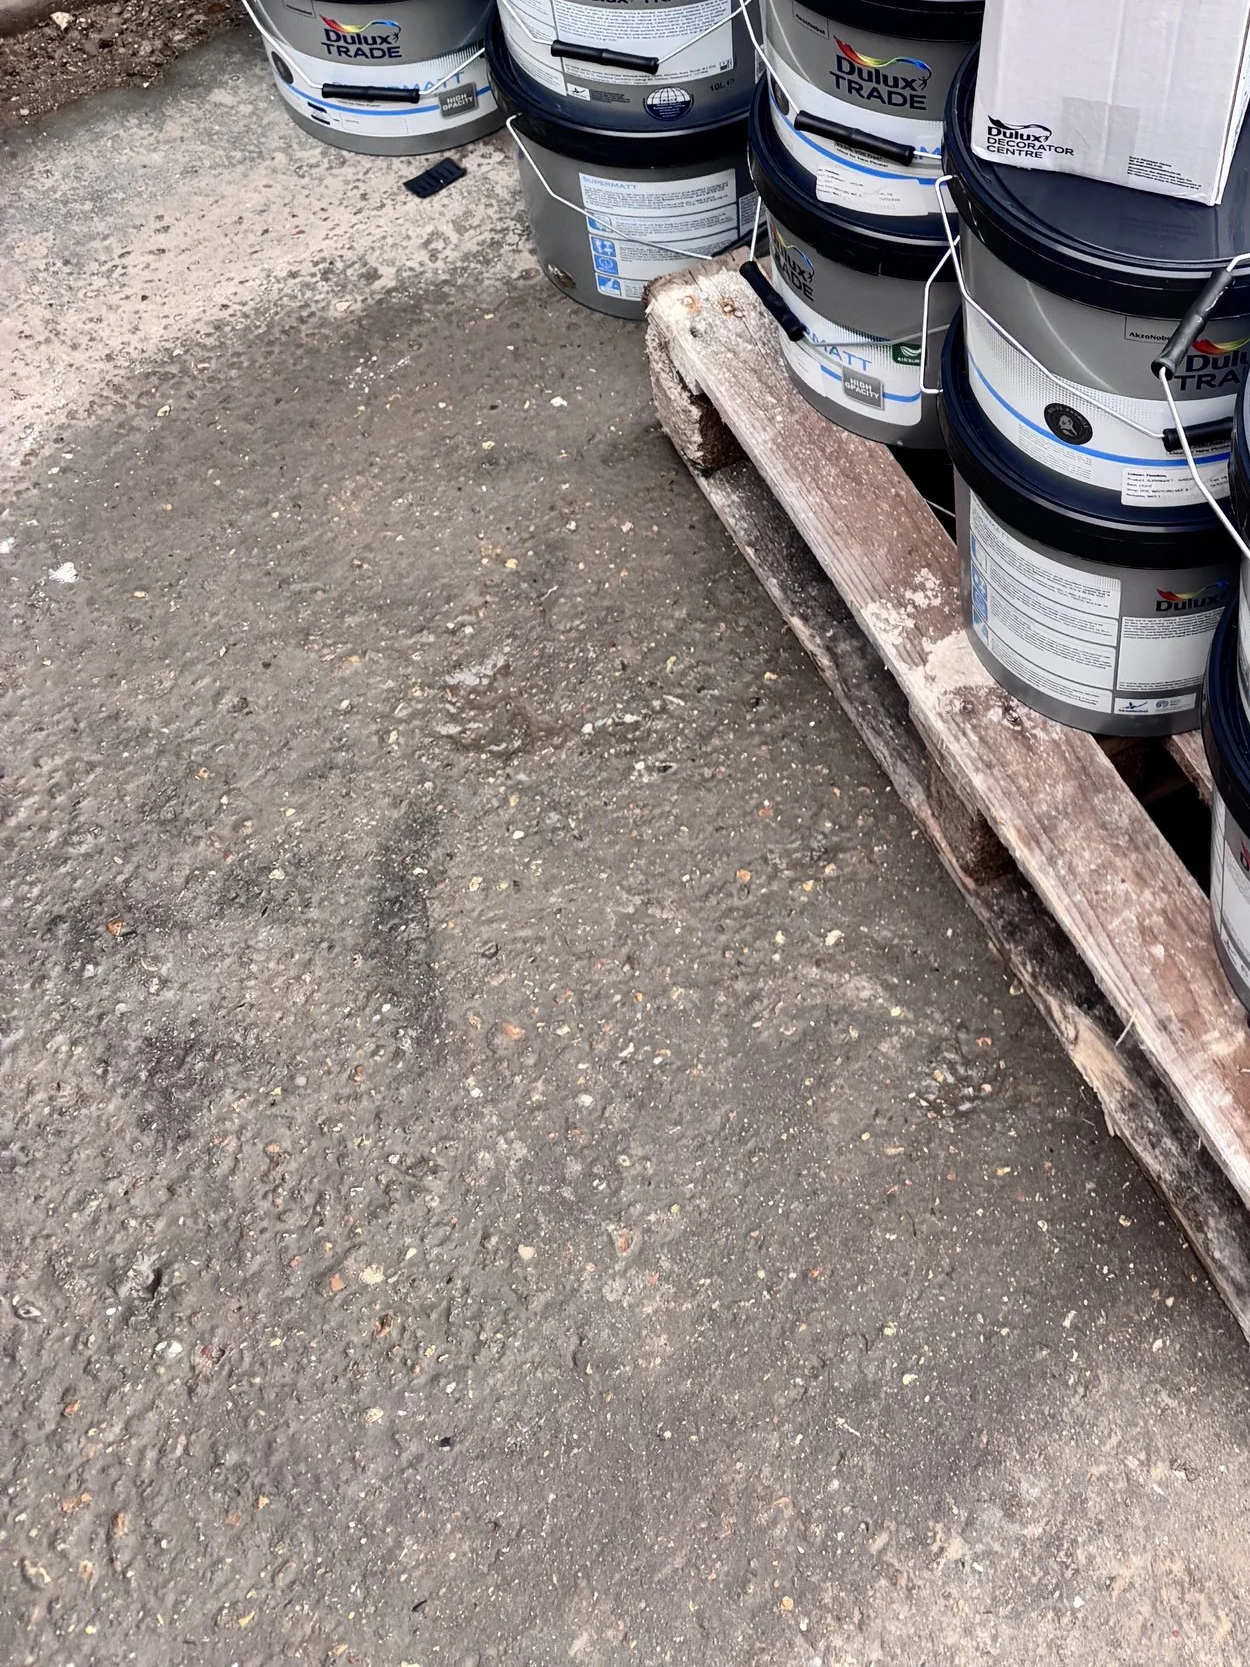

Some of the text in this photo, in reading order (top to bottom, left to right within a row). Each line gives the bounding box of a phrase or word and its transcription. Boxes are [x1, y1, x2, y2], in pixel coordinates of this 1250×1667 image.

[324, 27, 392, 45] Dulux
[321, 42, 402, 60] TRADE
[836, 54, 921, 93] Dulux
[446, 92, 467, 106] HIGH
[829, 70, 927, 112] TRADE
[442, 96, 474, 112] OPACITY
[987, 126, 1043, 144] Dulux
[986, 136, 1075, 157] DECORATOR
[986, 144, 1044, 159] CENTRE
[897, 355, 921, 365] AIRSUR
[849, 376, 872, 392] HIGH
[1173, 368, 1241, 391] TRA
[844, 380, 880, 401] OPACITY
[1155, 595, 1220, 612] Dulux
